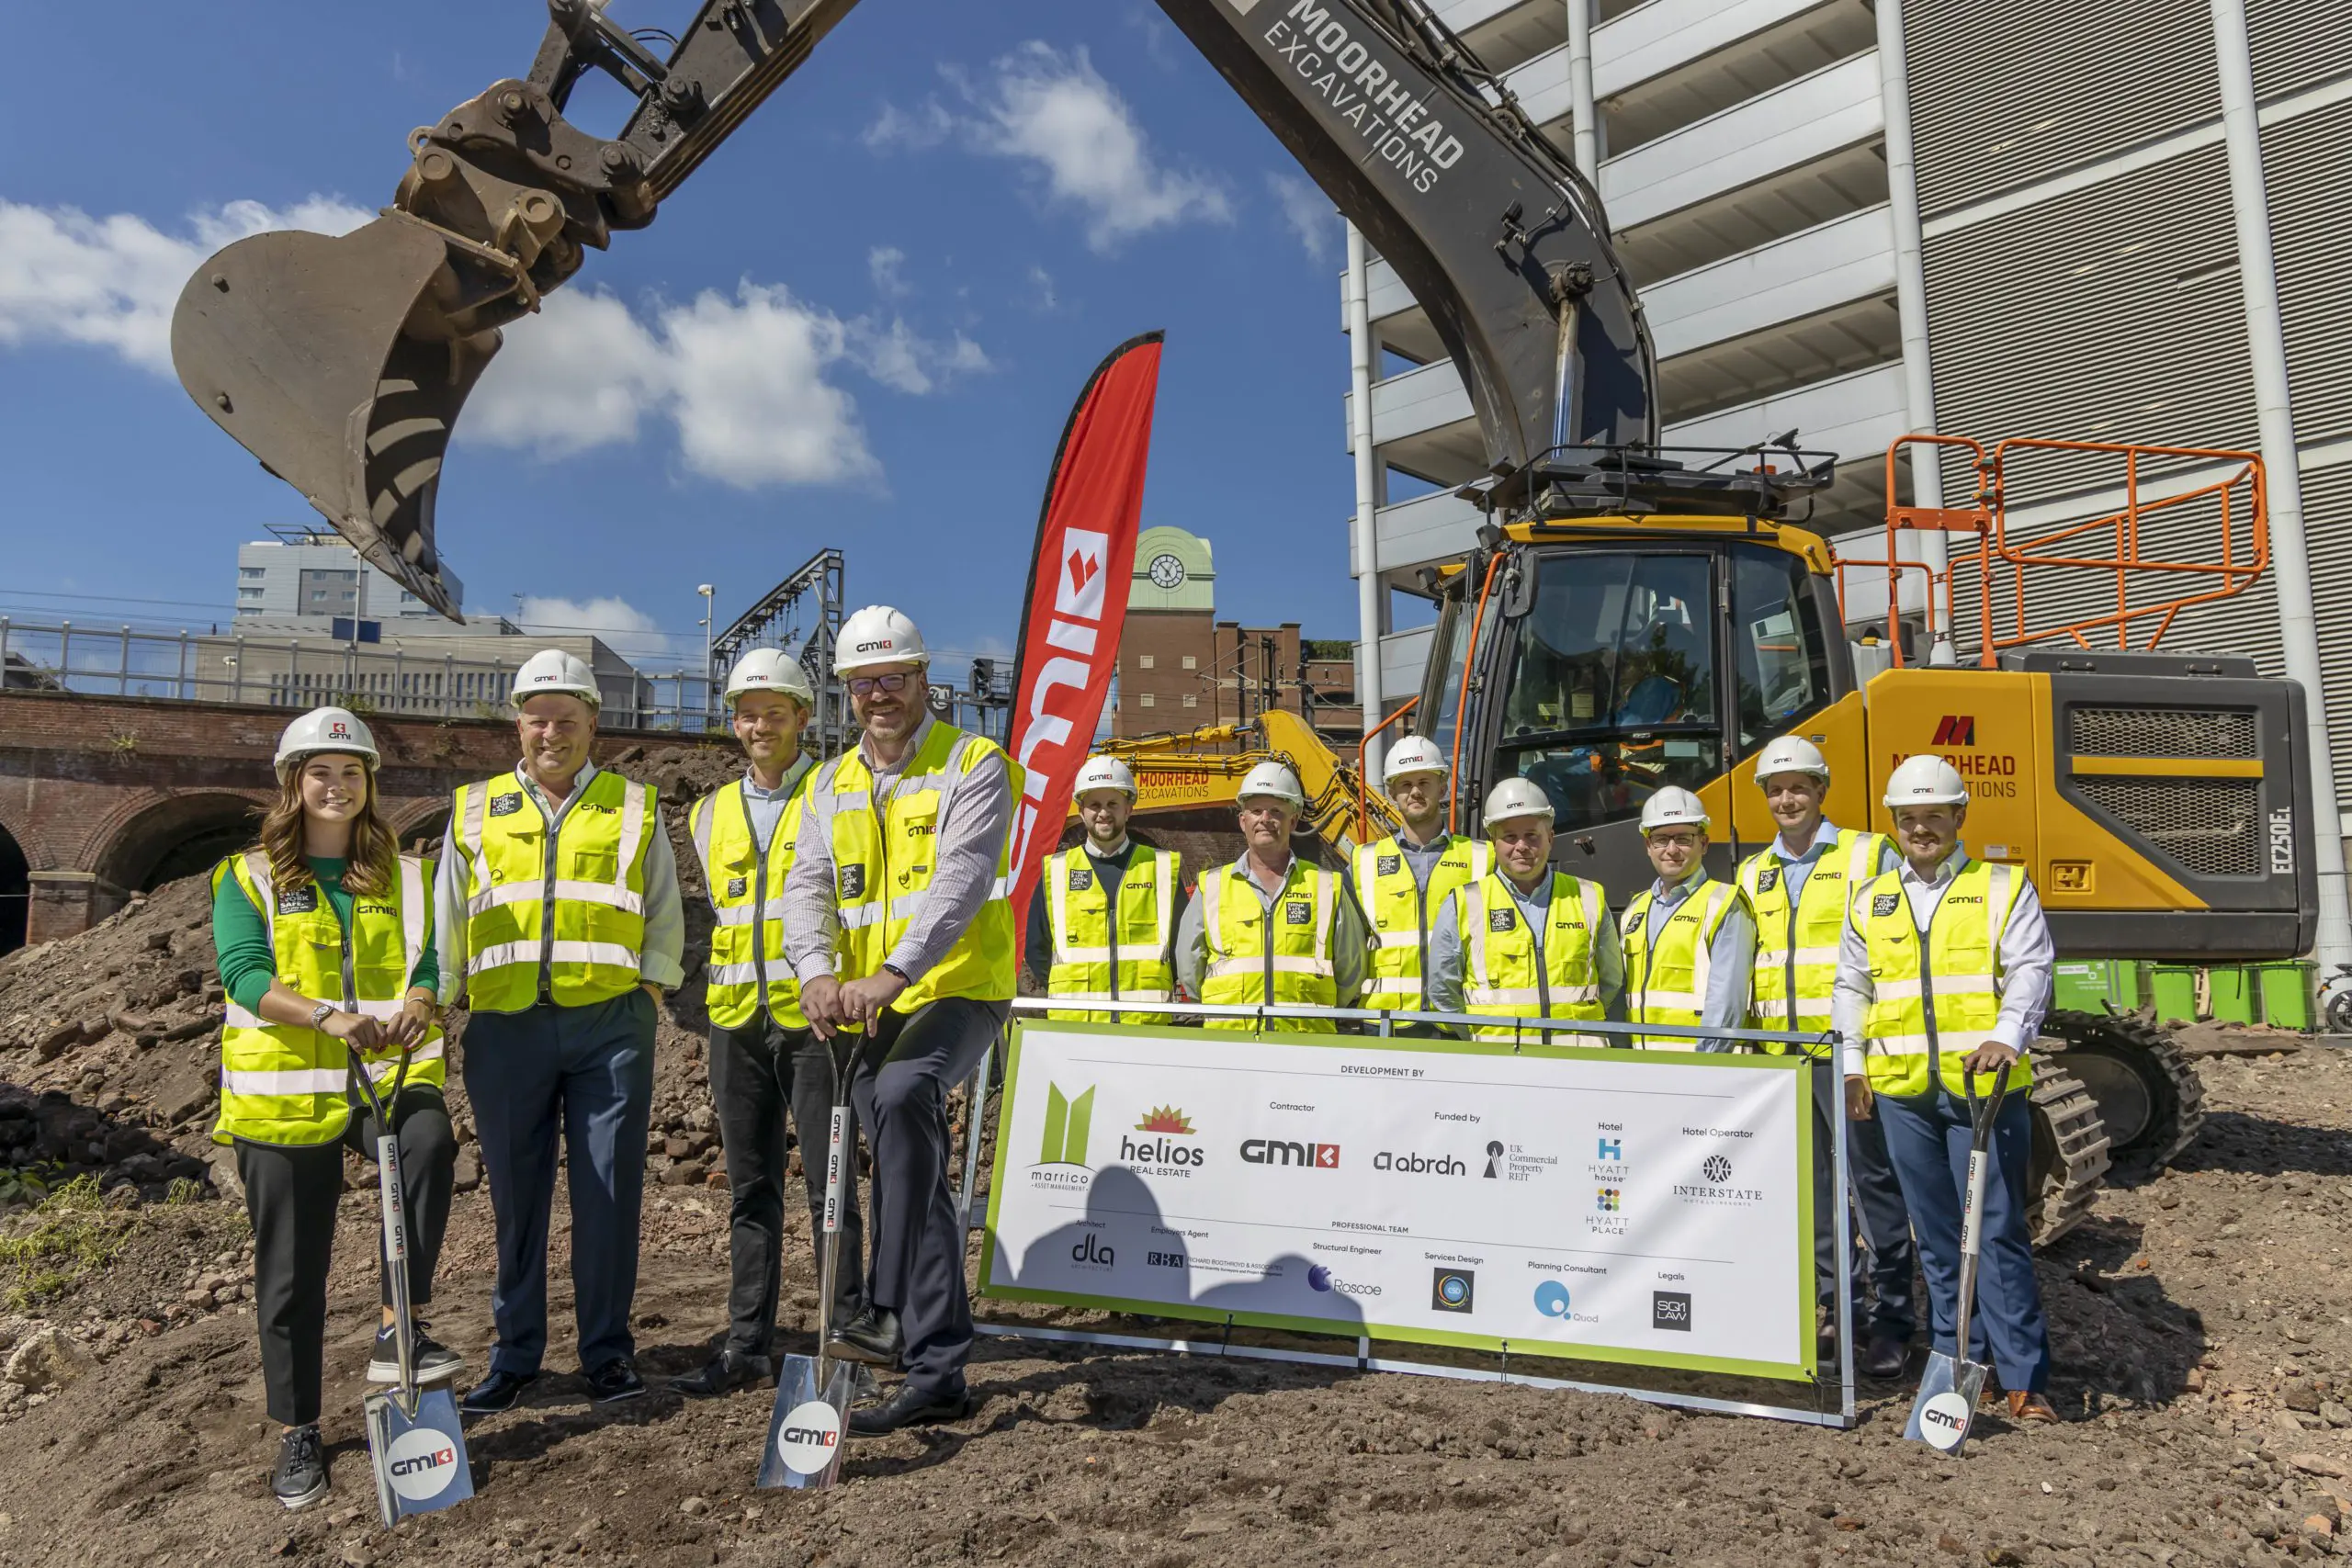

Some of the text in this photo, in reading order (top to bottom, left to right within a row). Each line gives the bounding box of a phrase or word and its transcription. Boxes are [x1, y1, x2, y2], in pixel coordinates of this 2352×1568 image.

[1287, 0, 1464, 169] MOORHEAD
[1264, 20, 1438, 193] EXCAVATIONS
[1893, 753, 2015, 775] MRHEAD
[1139, 770, 1209, 787] MOORHEAD
[1139, 786, 1209, 800] EXCAVATIONS
[1340, 1066, 1424, 1077] DEVELOPMENT BY
[1270, 1101, 1315, 1112] Contractor
[1434, 1112, 1480, 1124] Funded by
[1598, 1122, 1623, 1131] Hotel
[1682, 1127, 1753, 1138] Hotel Operator
[1120, 1134, 1204, 1167] helios
[1240, 1139, 1315, 1167] GMI
[1510, 1145, 1523, 1153] UK
[1396, 1152, 1466, 1177] abrdn
[1510, 1154, 1557, 1165] Commercial
[1129, 1166, 1192, 1178] REAL ESTATE
[1510, 1163, 1544, 1174] Property
[1589, 1165, 1629, 1175] HYATT
[1031, 1171, 1088, 1184] marrico
[1510, 1172, 1530, 1181] REIT
[1595, 1174, 1623, 1182] house
[1673, 1185, 1762, 1201] INTERSTATE
[1075, 1220, 1105, 1228] Architect
[1586, 1215, 1629, 1226] HYATT
[1332, 1222, 1386, 1232] PROFESSIONAL
[1592, 1226, 1623, 1235] PLACE
[1187, 1230, 1208, 1239] Agent
[1072, 1233, 1114, 1267] dla
[1313, 1242, 1382, 1256] Structural Engineer
[1148, 1251, 1182, 1268] RBA
[1425, 1252, 1484, 1265] Services Design
[1528, 1261, 1607, 1274] Planning Consultant
[1657, 1271, 1685, 1281] Legals
[1333, 1279, 1382, 1296] Roscoe
[1657, 1300, 1686, 1312] SQ1
[1573, 1313, 1599, 1324] Quod
[1657, 1311, 1687, 1321] LAW
[1926, 1409, 1958, 1429] GMI
[785, 1427, 826, 1446] GMI
[390, 1453, 437, 1476] GMI
